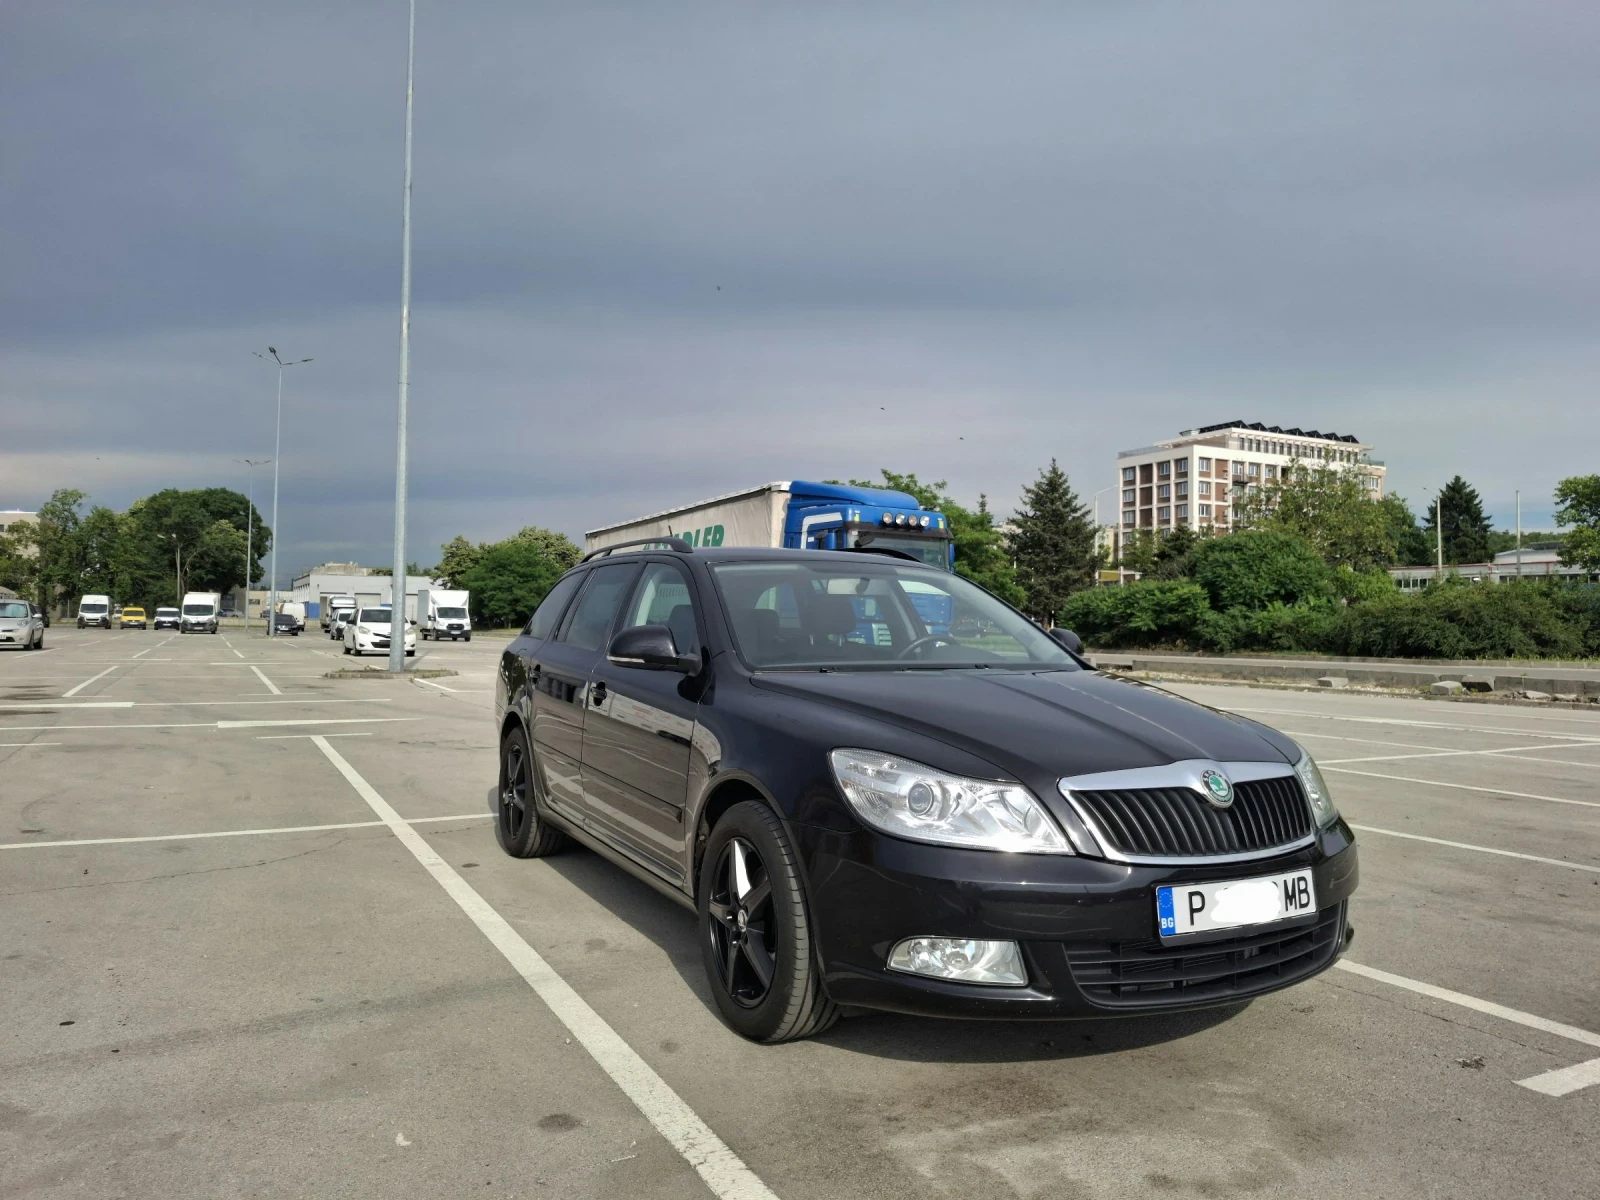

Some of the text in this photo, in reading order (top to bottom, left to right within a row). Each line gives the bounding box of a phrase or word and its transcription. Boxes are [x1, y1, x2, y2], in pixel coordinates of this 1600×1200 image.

[1188, 890, 1206, 926] P
[1283, 876, 1311, 912] MB
[1161, 917, 1174, 929] BG
